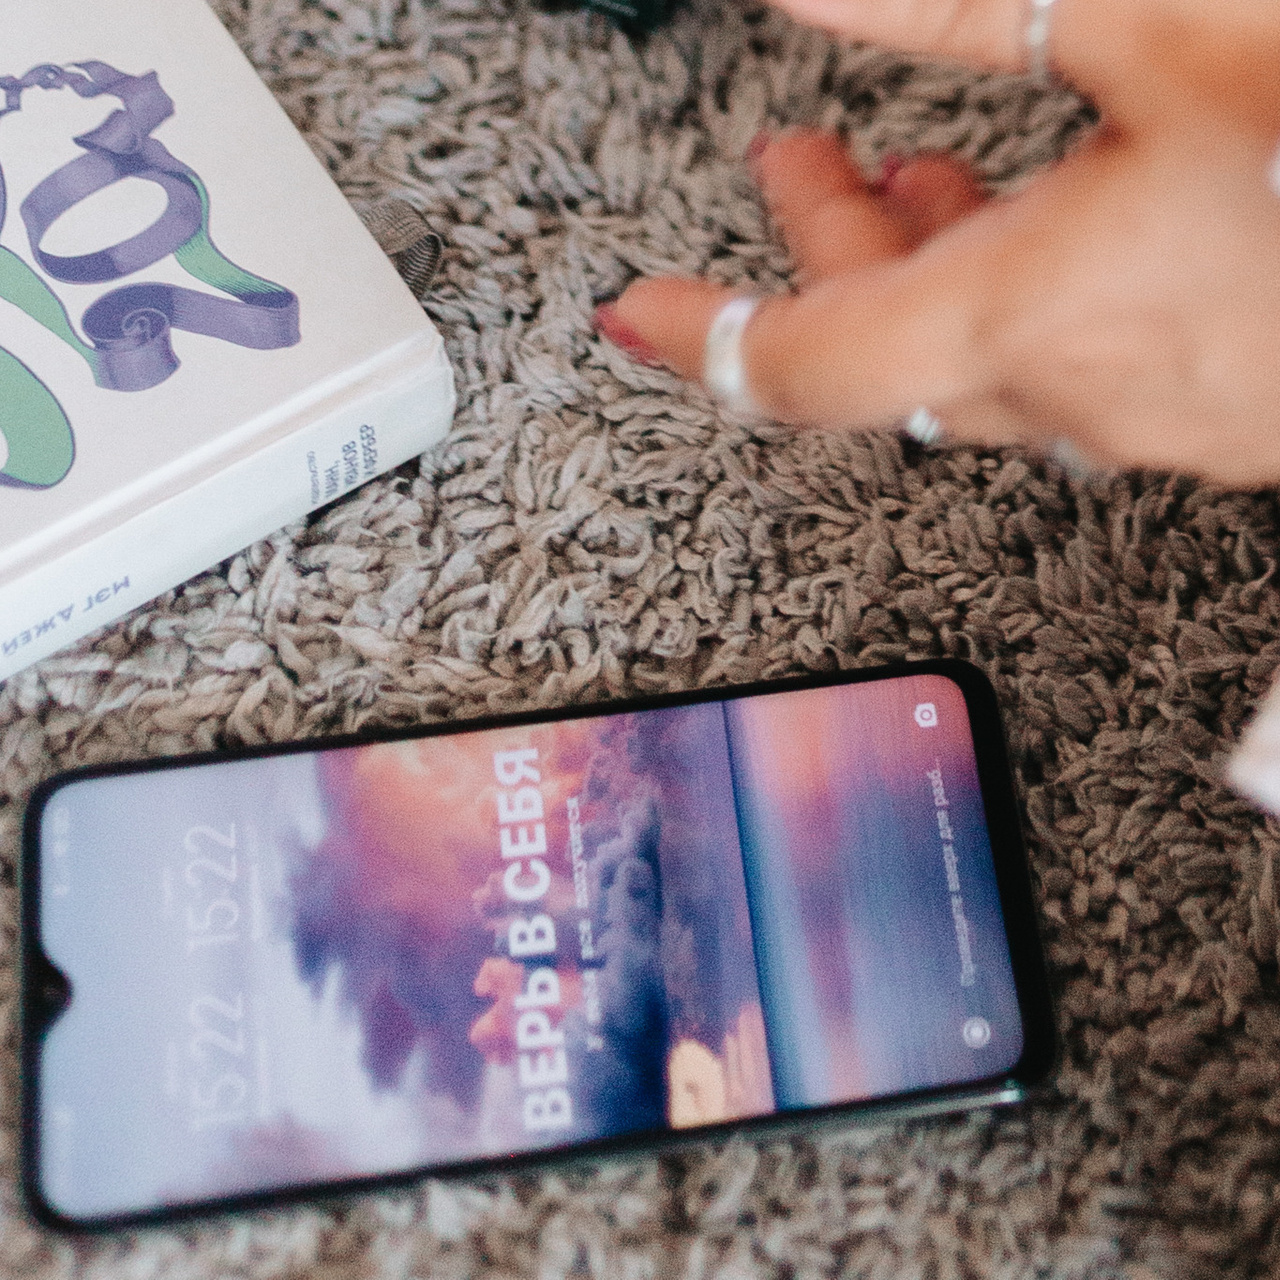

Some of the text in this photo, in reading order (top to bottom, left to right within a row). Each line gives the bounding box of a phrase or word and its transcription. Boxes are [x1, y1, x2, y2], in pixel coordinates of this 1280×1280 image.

[2, 575, 131, 655] МЭГ ДЖЕЙ
[493, 747, 573, 1131] ВЕРЬ В СЕБЯ
